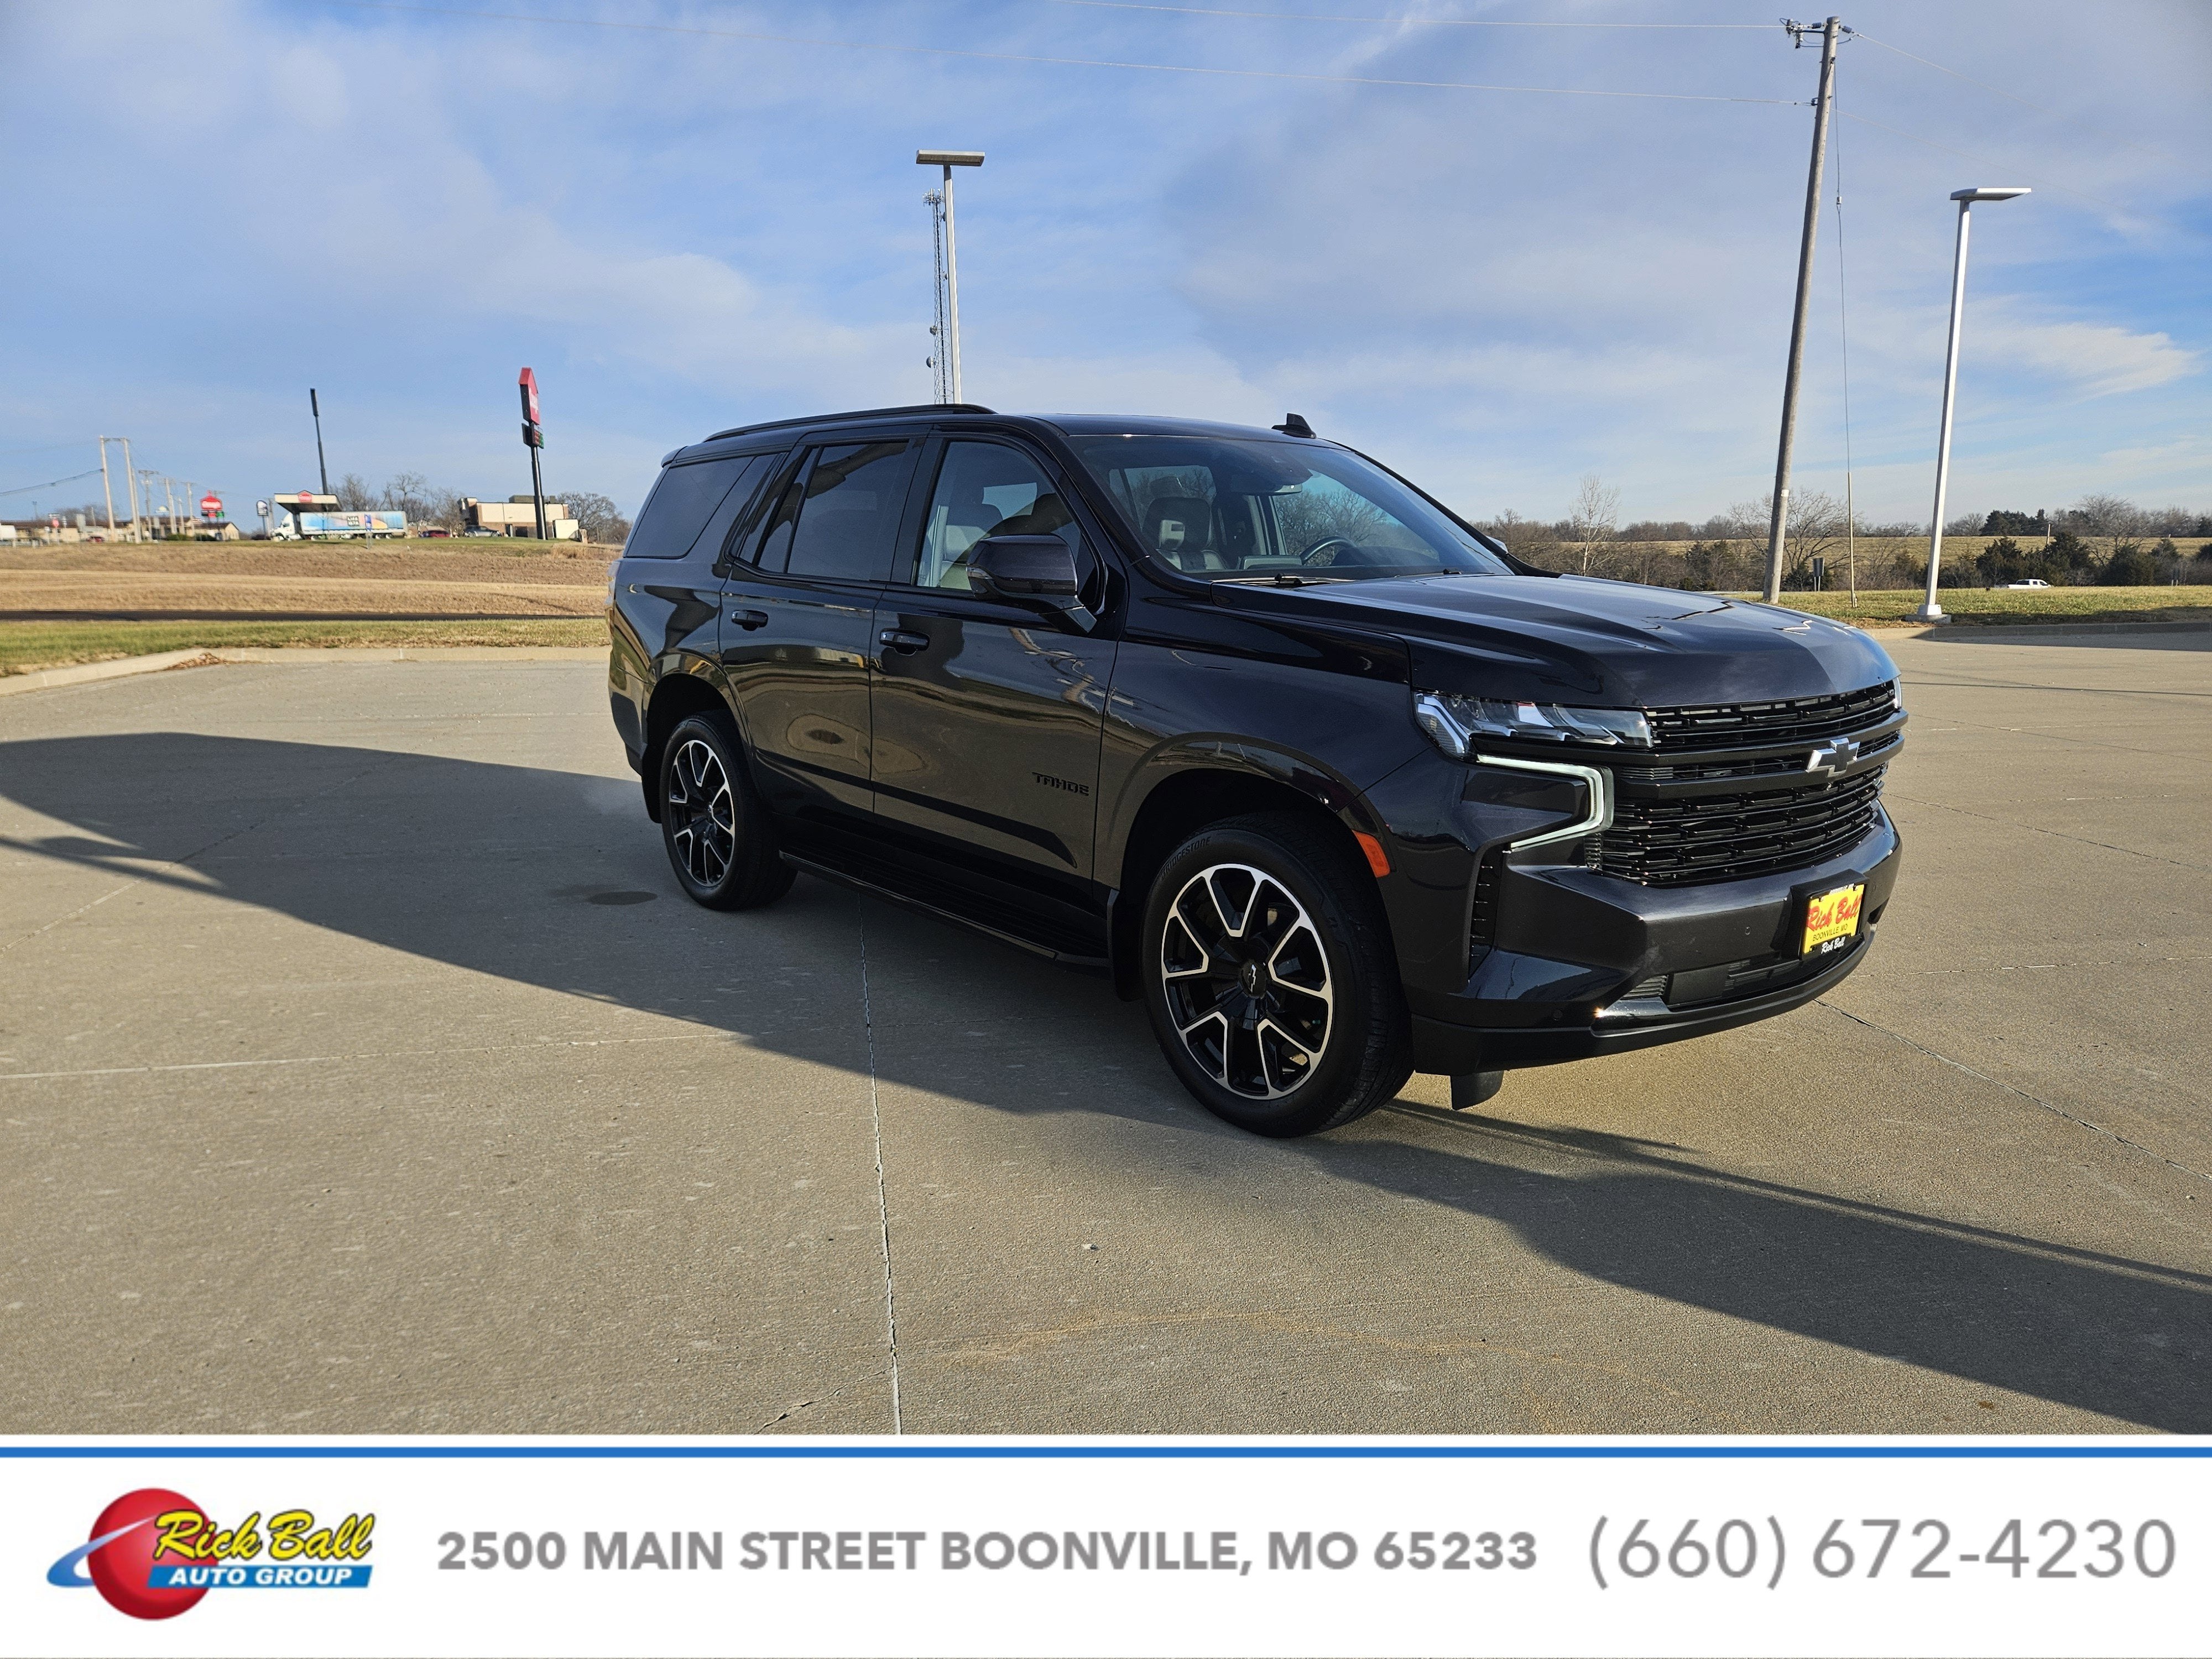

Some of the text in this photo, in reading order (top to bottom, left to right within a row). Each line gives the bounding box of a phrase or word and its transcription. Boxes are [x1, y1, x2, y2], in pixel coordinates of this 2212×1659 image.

[1032, 771, 1089, 796] TAHOE
[1160, 836, 1211, 879] BRIDGESTONE
[1806, 894, 1863, 932] Rick Ball
[1840, 924, 1848, 932] MO
[1820, 936, 1846, 954] Rick Ball
